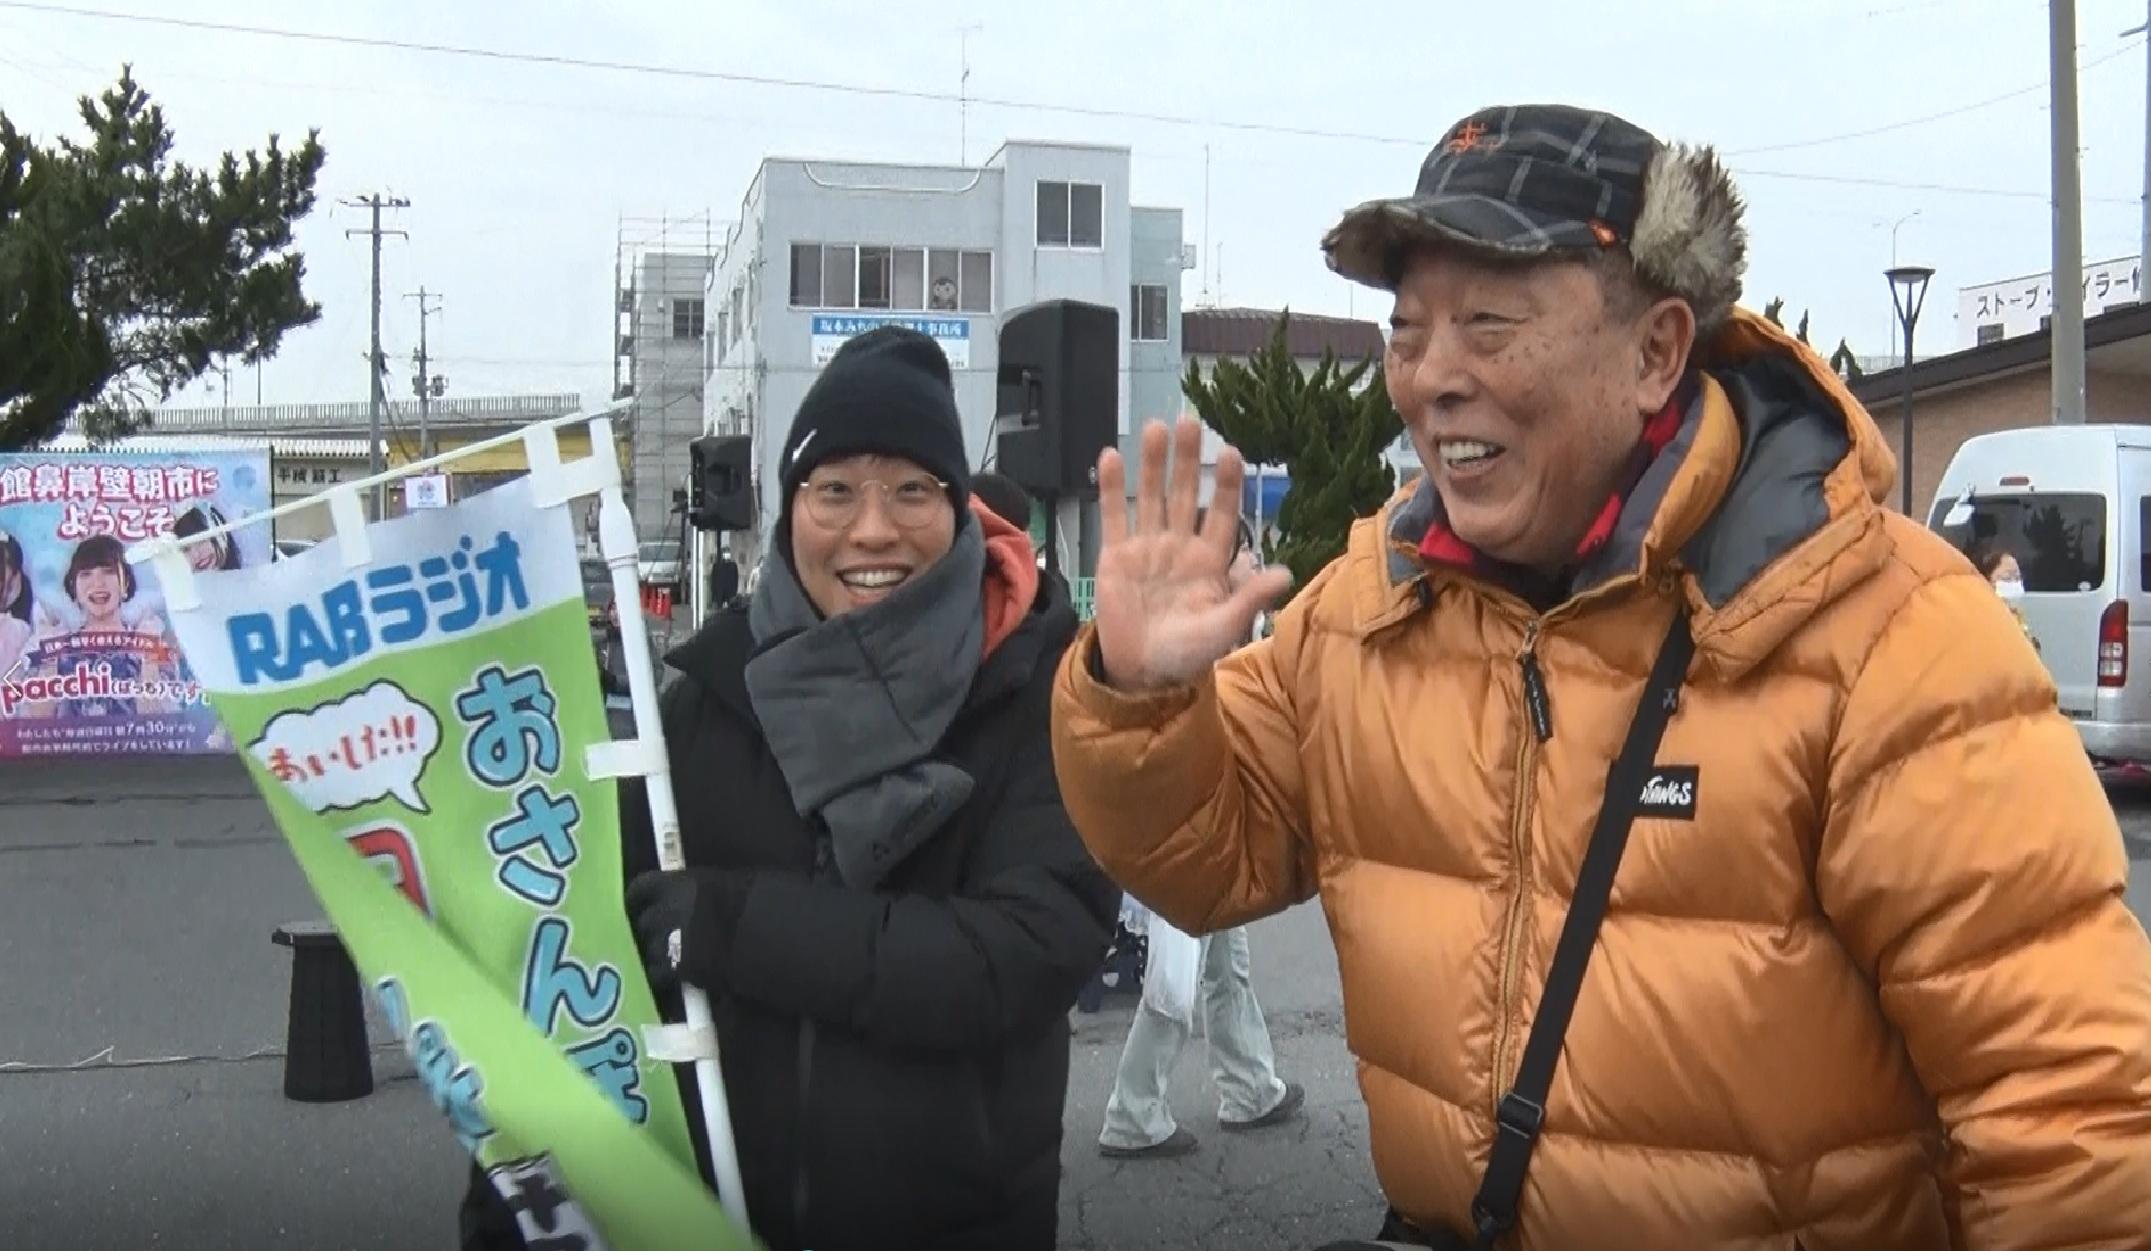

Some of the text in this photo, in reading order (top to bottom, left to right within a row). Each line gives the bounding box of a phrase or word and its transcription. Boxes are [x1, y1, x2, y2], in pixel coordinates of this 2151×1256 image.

[60, 503, 175, 540] ようこそ
[226, 530, 529, 685] RABラジオ
